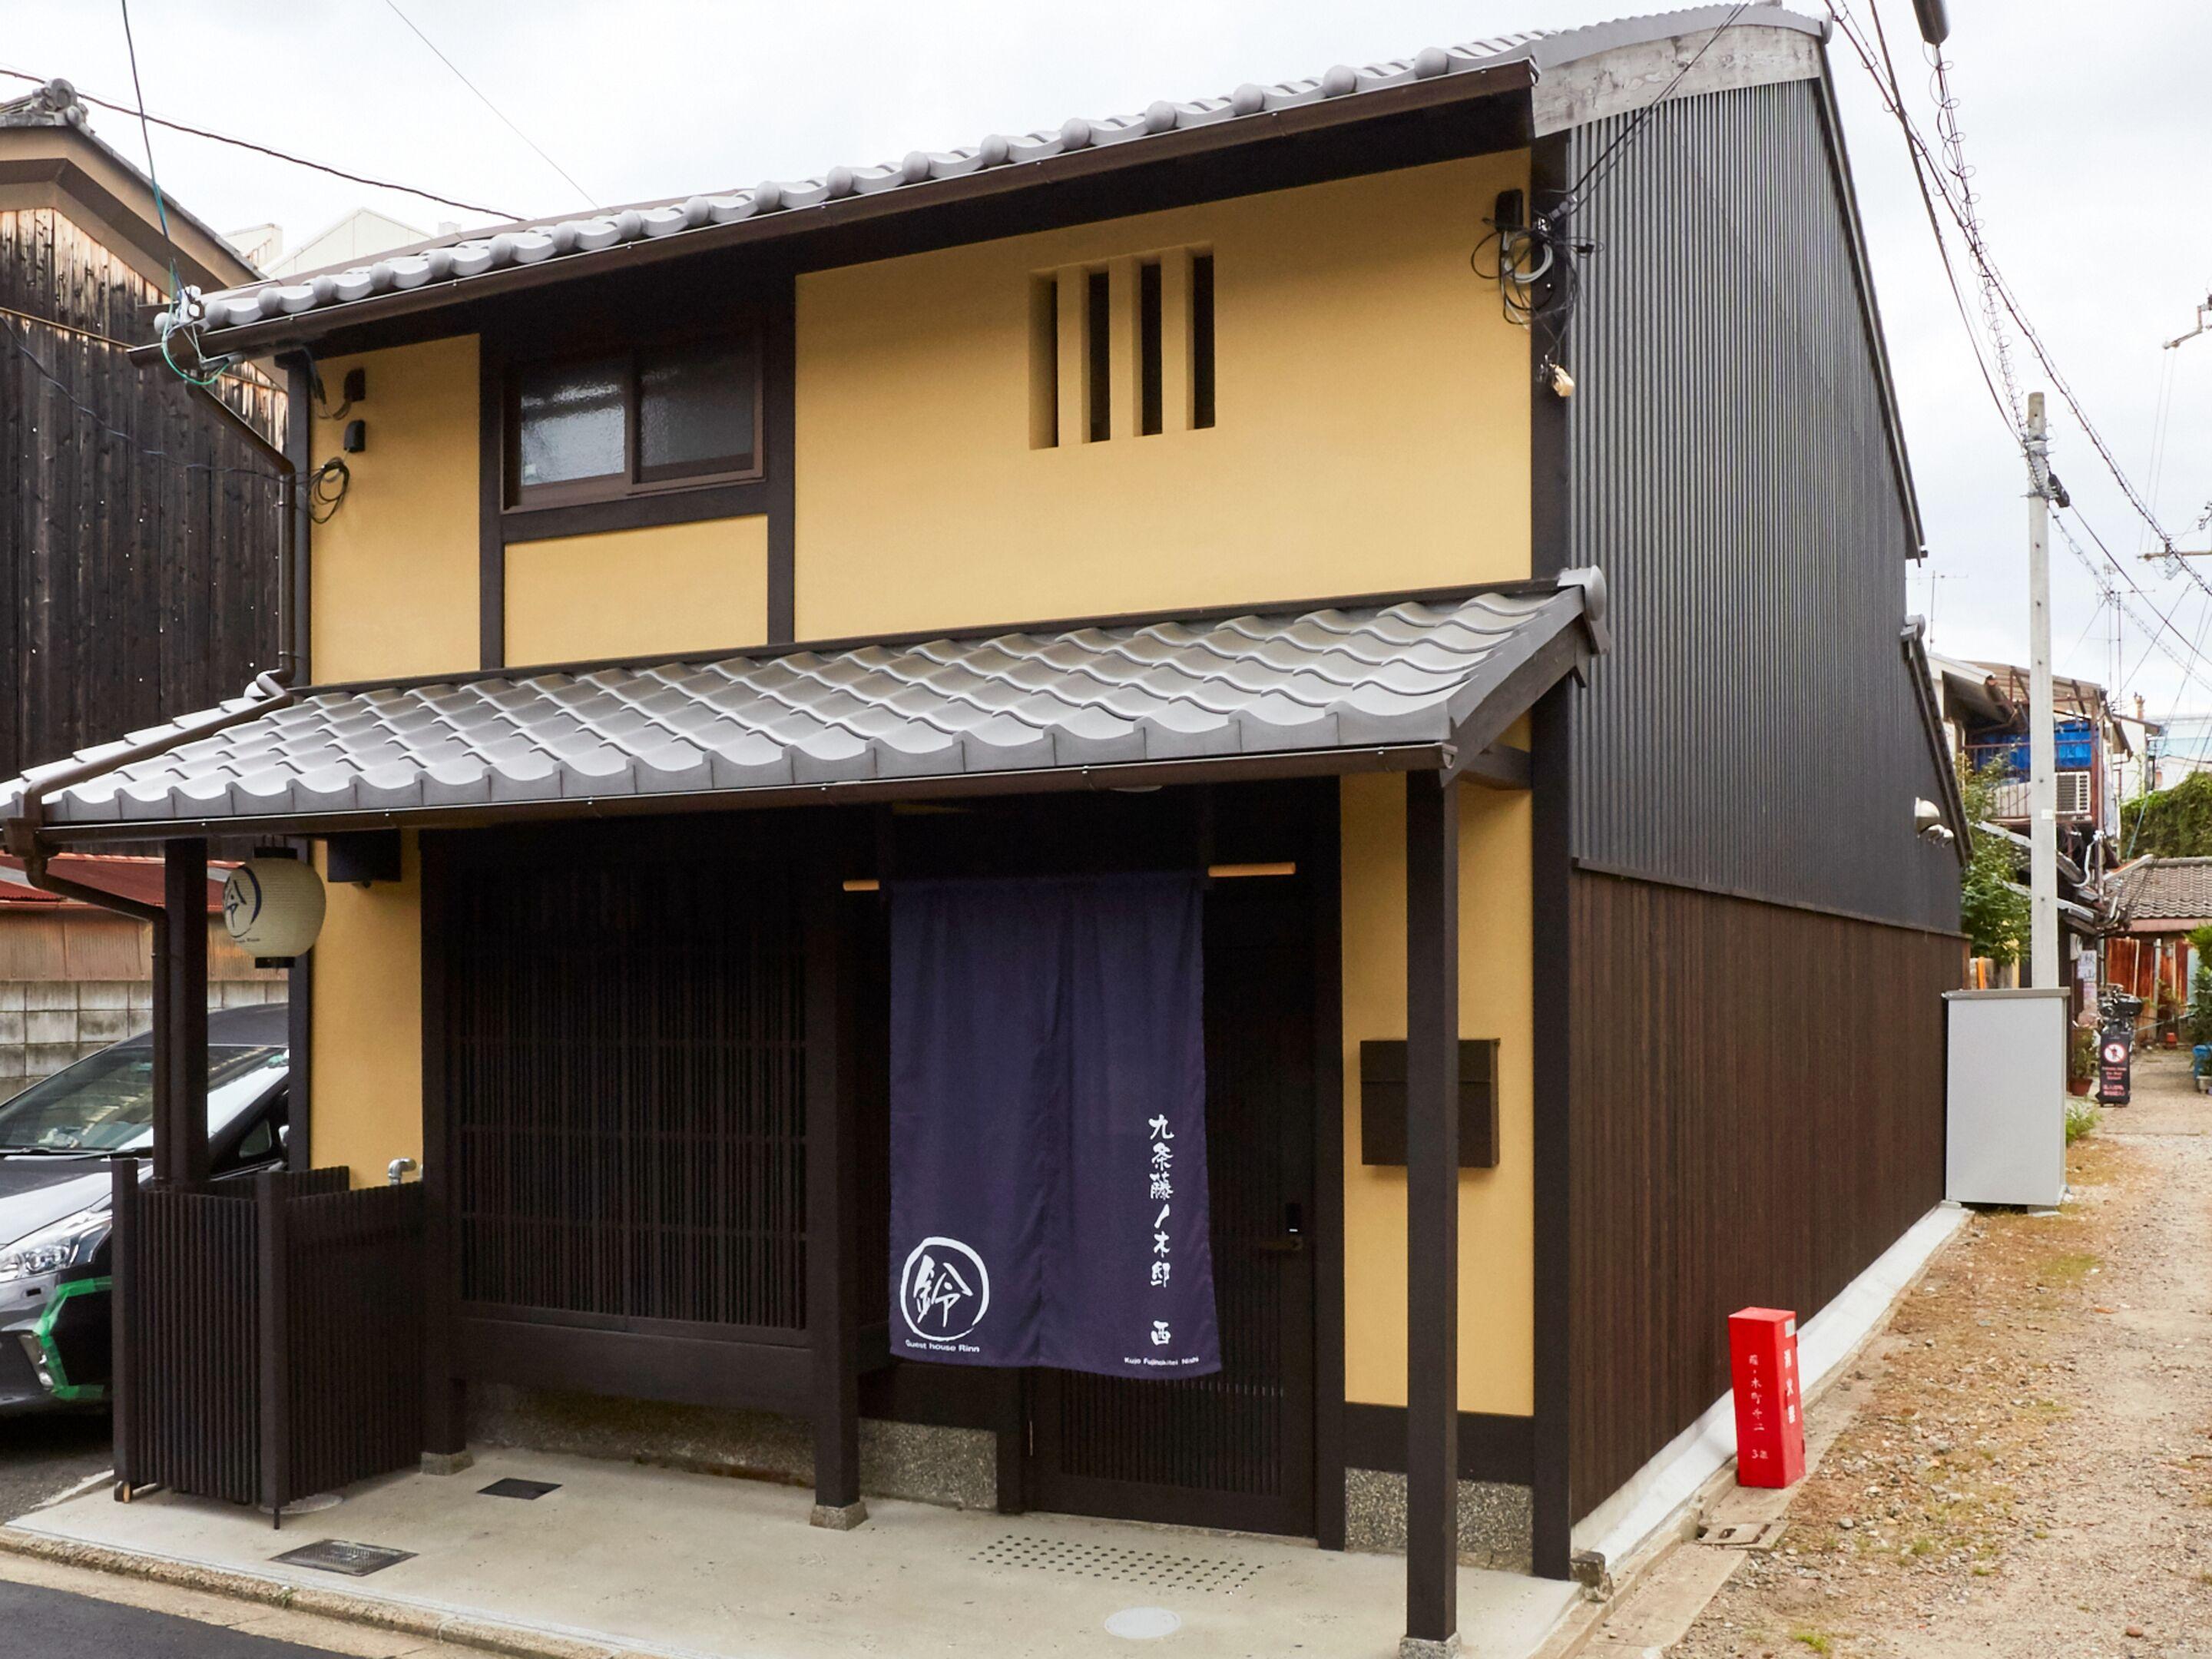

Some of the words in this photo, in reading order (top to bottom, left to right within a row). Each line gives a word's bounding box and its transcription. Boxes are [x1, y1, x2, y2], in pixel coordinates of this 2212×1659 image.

[905, 1339, 927, 1349] Guest
[929, 1342, 957, 1352] house
[958, 1343, 981, 1353] Rinn
